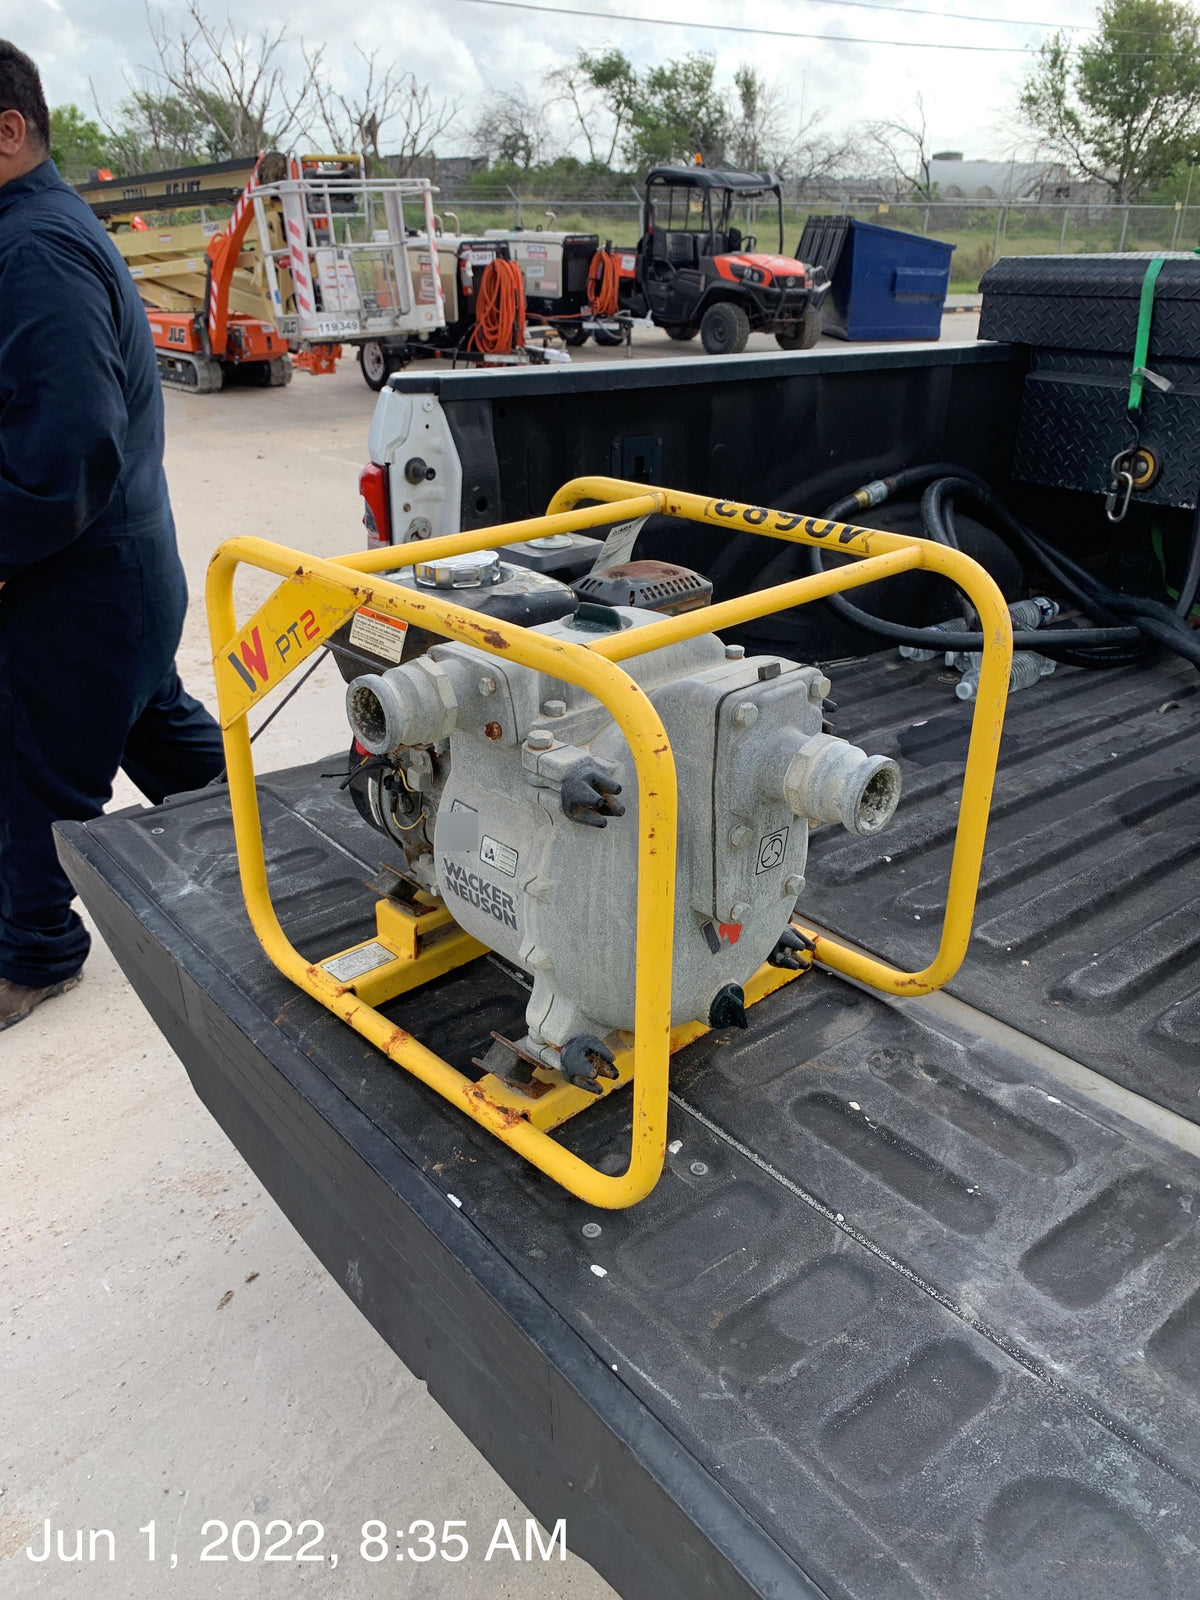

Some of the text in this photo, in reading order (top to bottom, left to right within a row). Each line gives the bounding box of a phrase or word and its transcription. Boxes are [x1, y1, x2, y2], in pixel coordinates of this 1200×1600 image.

[168, 327, 186, 344] JLG
[281, 320, 298, 334] JLG
[318, 320, 358, 332] 119349
[275, 610, 321, 663] PT2
[443, 857, 516, 914] WACKER
[445, 875, 518, 931] NEUSON
